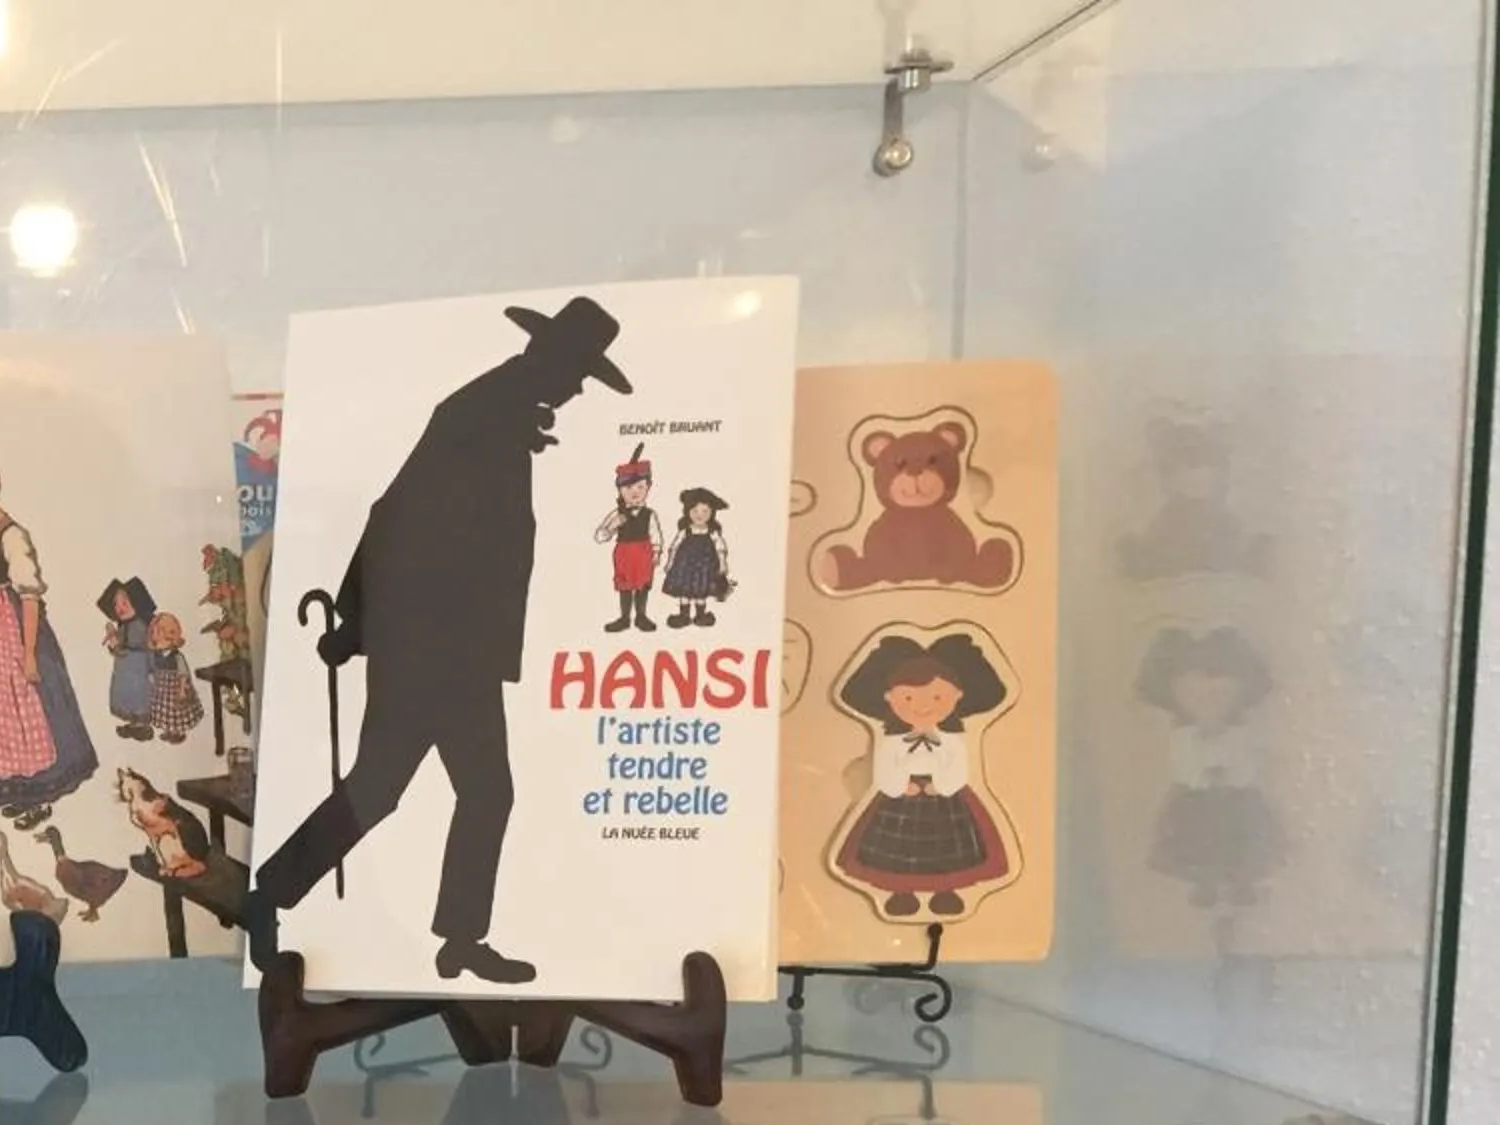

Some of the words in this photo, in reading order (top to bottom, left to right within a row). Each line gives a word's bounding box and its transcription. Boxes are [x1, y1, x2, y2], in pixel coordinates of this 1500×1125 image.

[549, 648, 771, 709] HANSI
[597, 715, 721, 745] l'artiste
[608, 752, 708, 780] tendre
[583, 788, 613, 815] et
[623, 785, 729, 815] rebelle
[602, 826, 619, 840] LA
[621, 825, 656, 840] NUÉE
[659, 826, 701, 840] BLEUE
